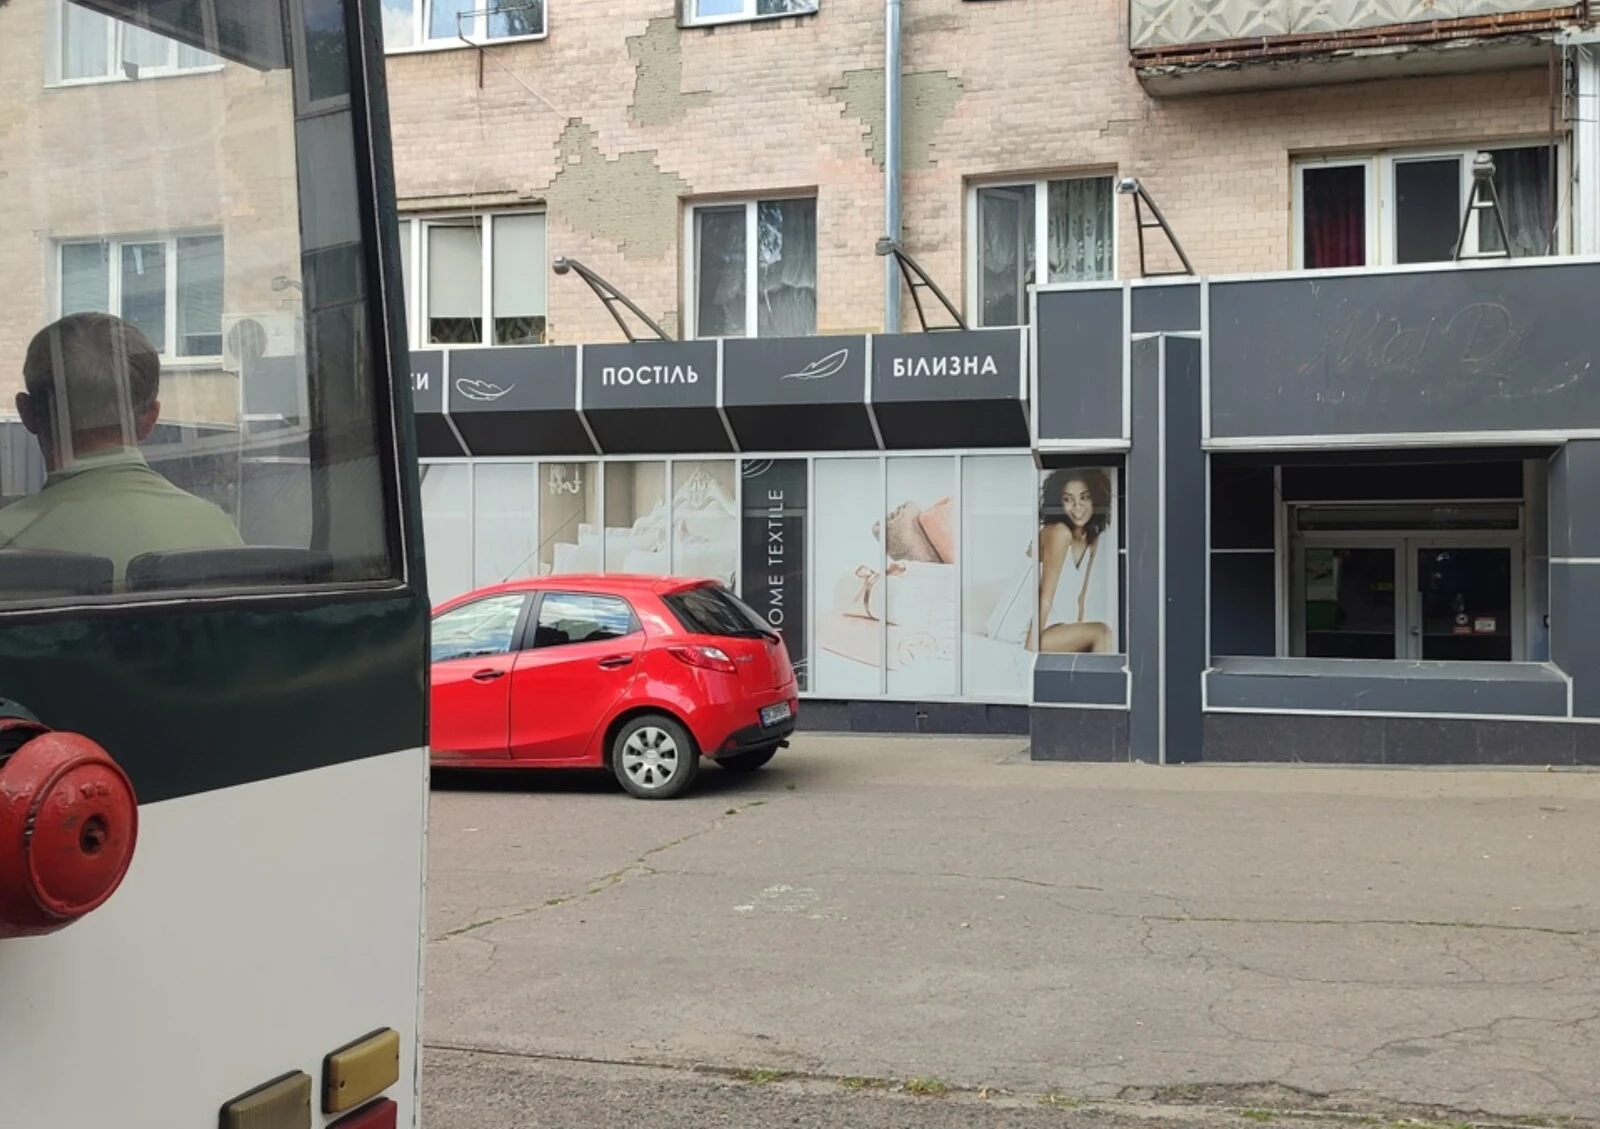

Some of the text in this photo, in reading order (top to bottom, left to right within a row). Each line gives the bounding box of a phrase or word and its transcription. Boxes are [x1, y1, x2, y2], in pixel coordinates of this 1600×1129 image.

[602, 365, 699, 388] ПОСТІЛЬ
[893, 355, 998, 378] БІЛИЗНА
[410, 372, 429, 390] И
[768, 490, 783, 566] TEXTILE
